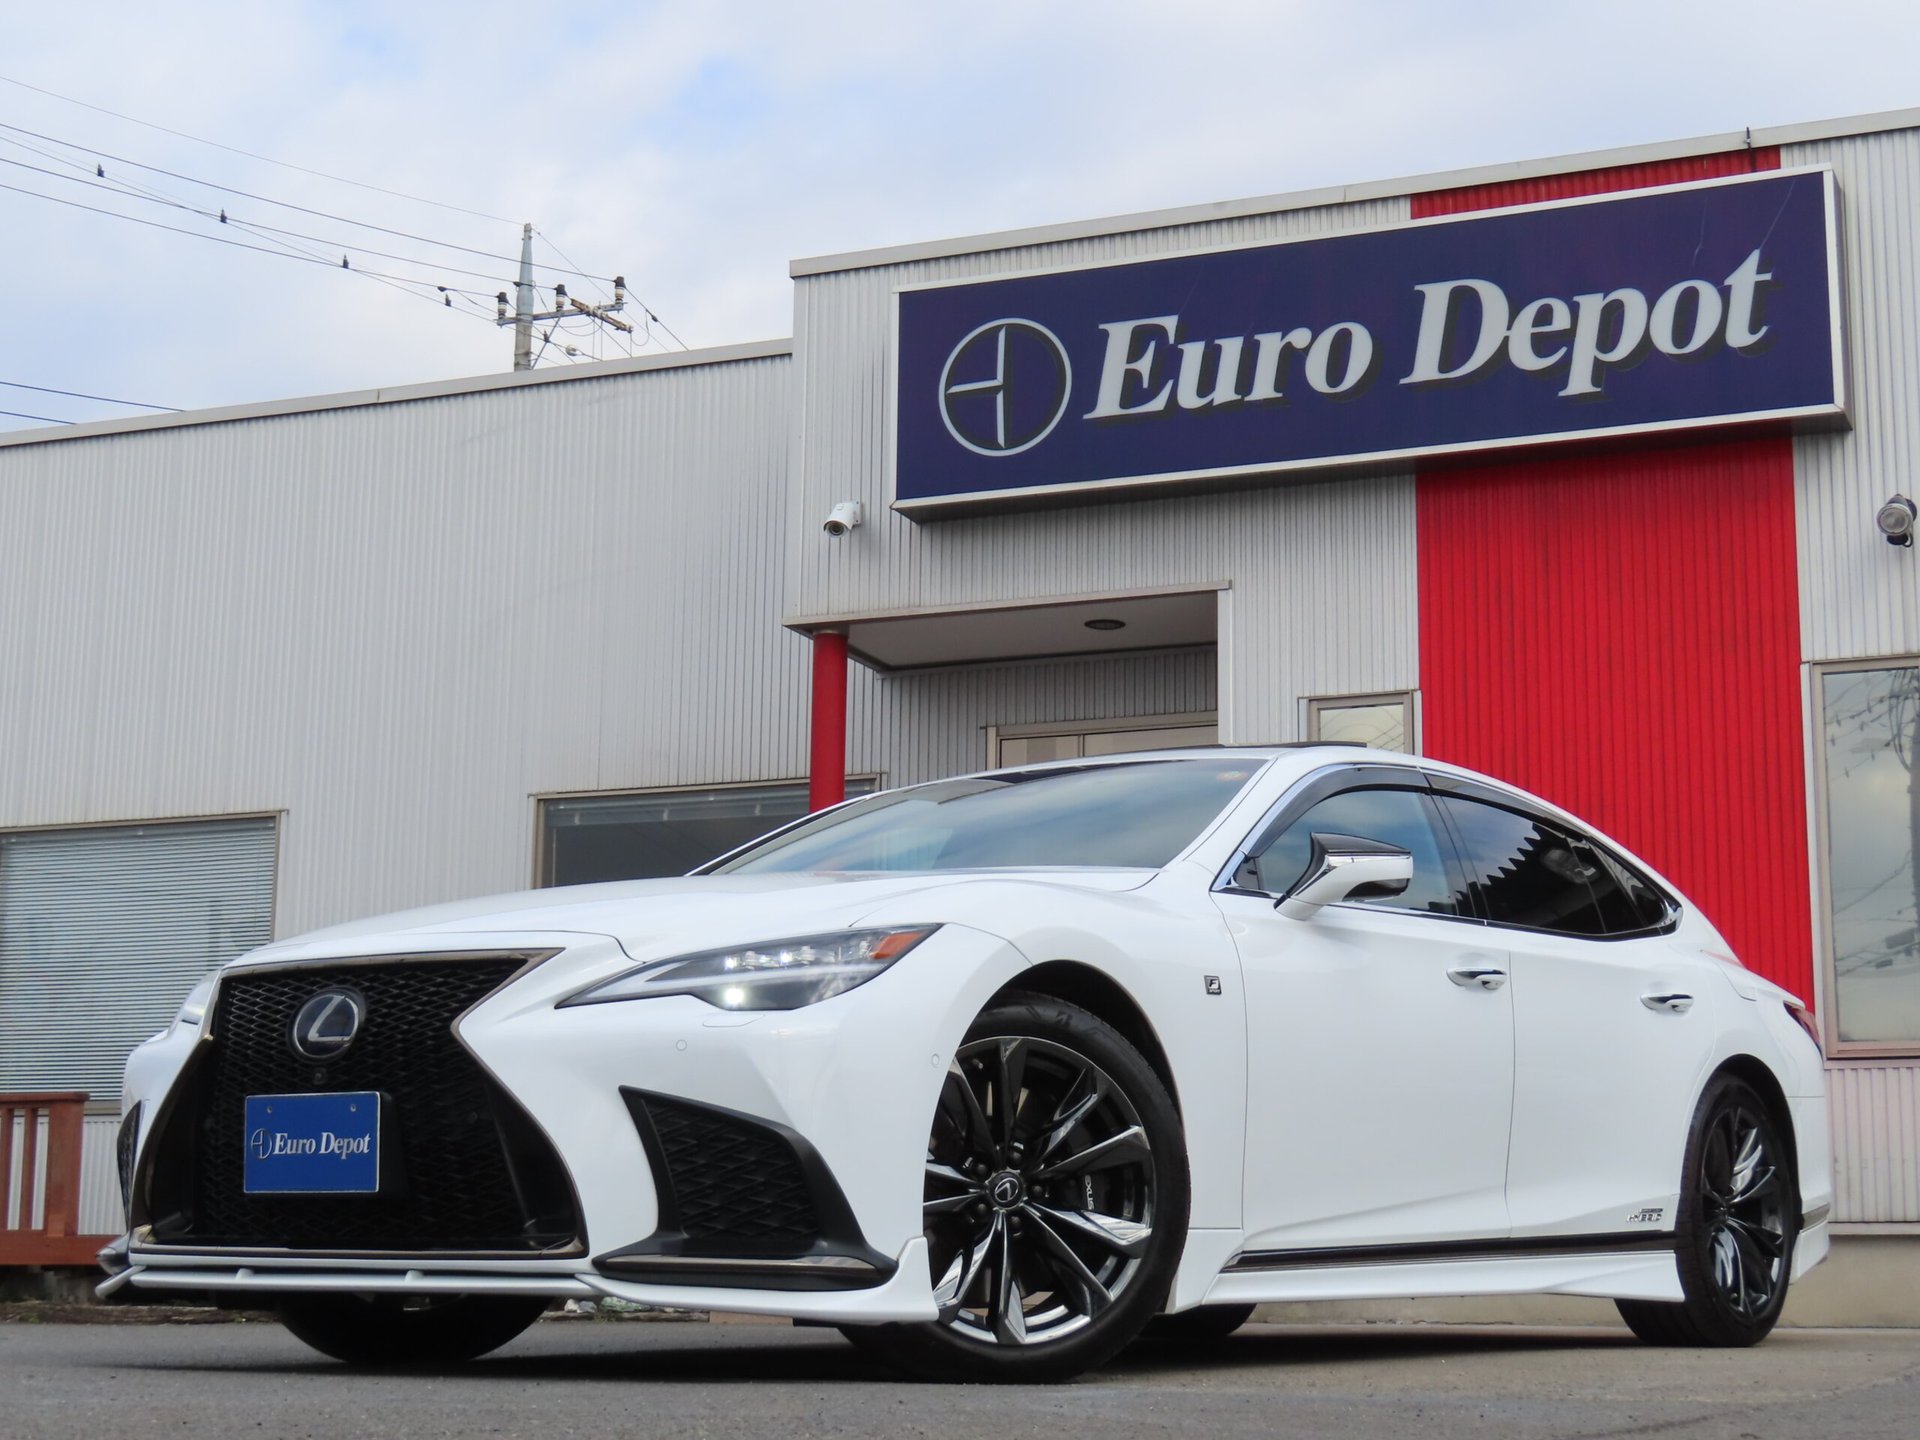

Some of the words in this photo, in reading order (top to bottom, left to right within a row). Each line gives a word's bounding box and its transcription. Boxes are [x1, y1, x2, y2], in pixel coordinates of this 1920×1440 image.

[1083, 315, 1373, 420] Euro
[1400, 250, 1772, 397] Depot
[273, 1132, 316, 1155] Euro
[319, 1132, 371, 1160] Depot
